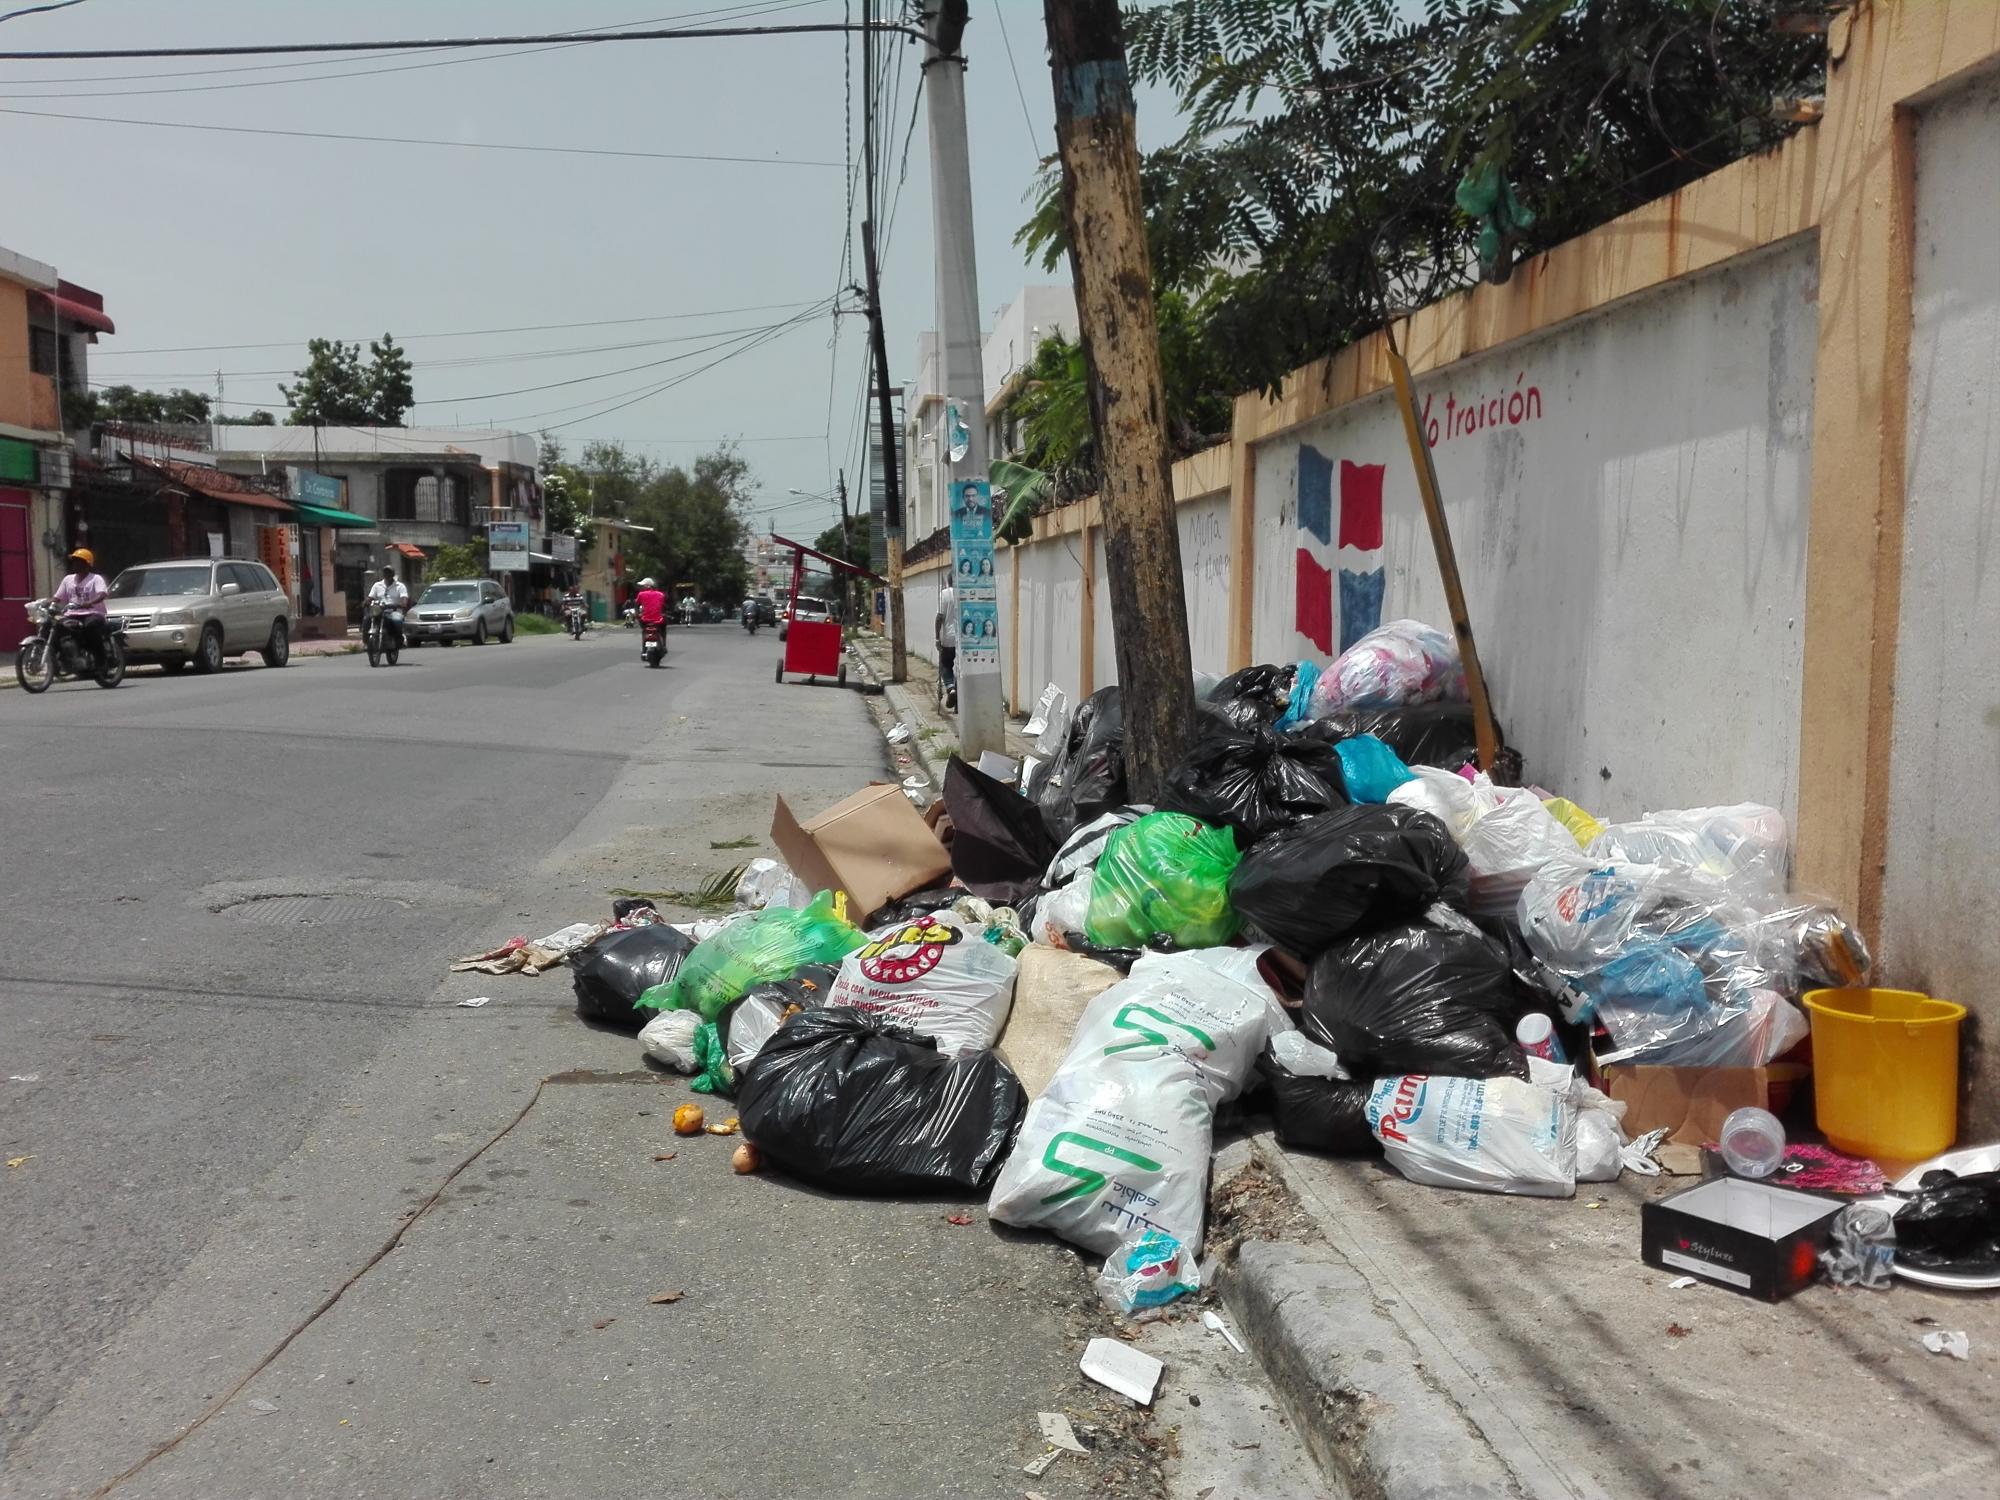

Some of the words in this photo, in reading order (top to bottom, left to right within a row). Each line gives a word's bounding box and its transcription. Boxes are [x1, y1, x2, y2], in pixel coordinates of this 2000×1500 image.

[1445, 370, 1542, 441] traición
[863, 947, 940, 981] Mercado
[850, 983, 865, 995] con
[1112, 1181, 1160, 1206] sabic
